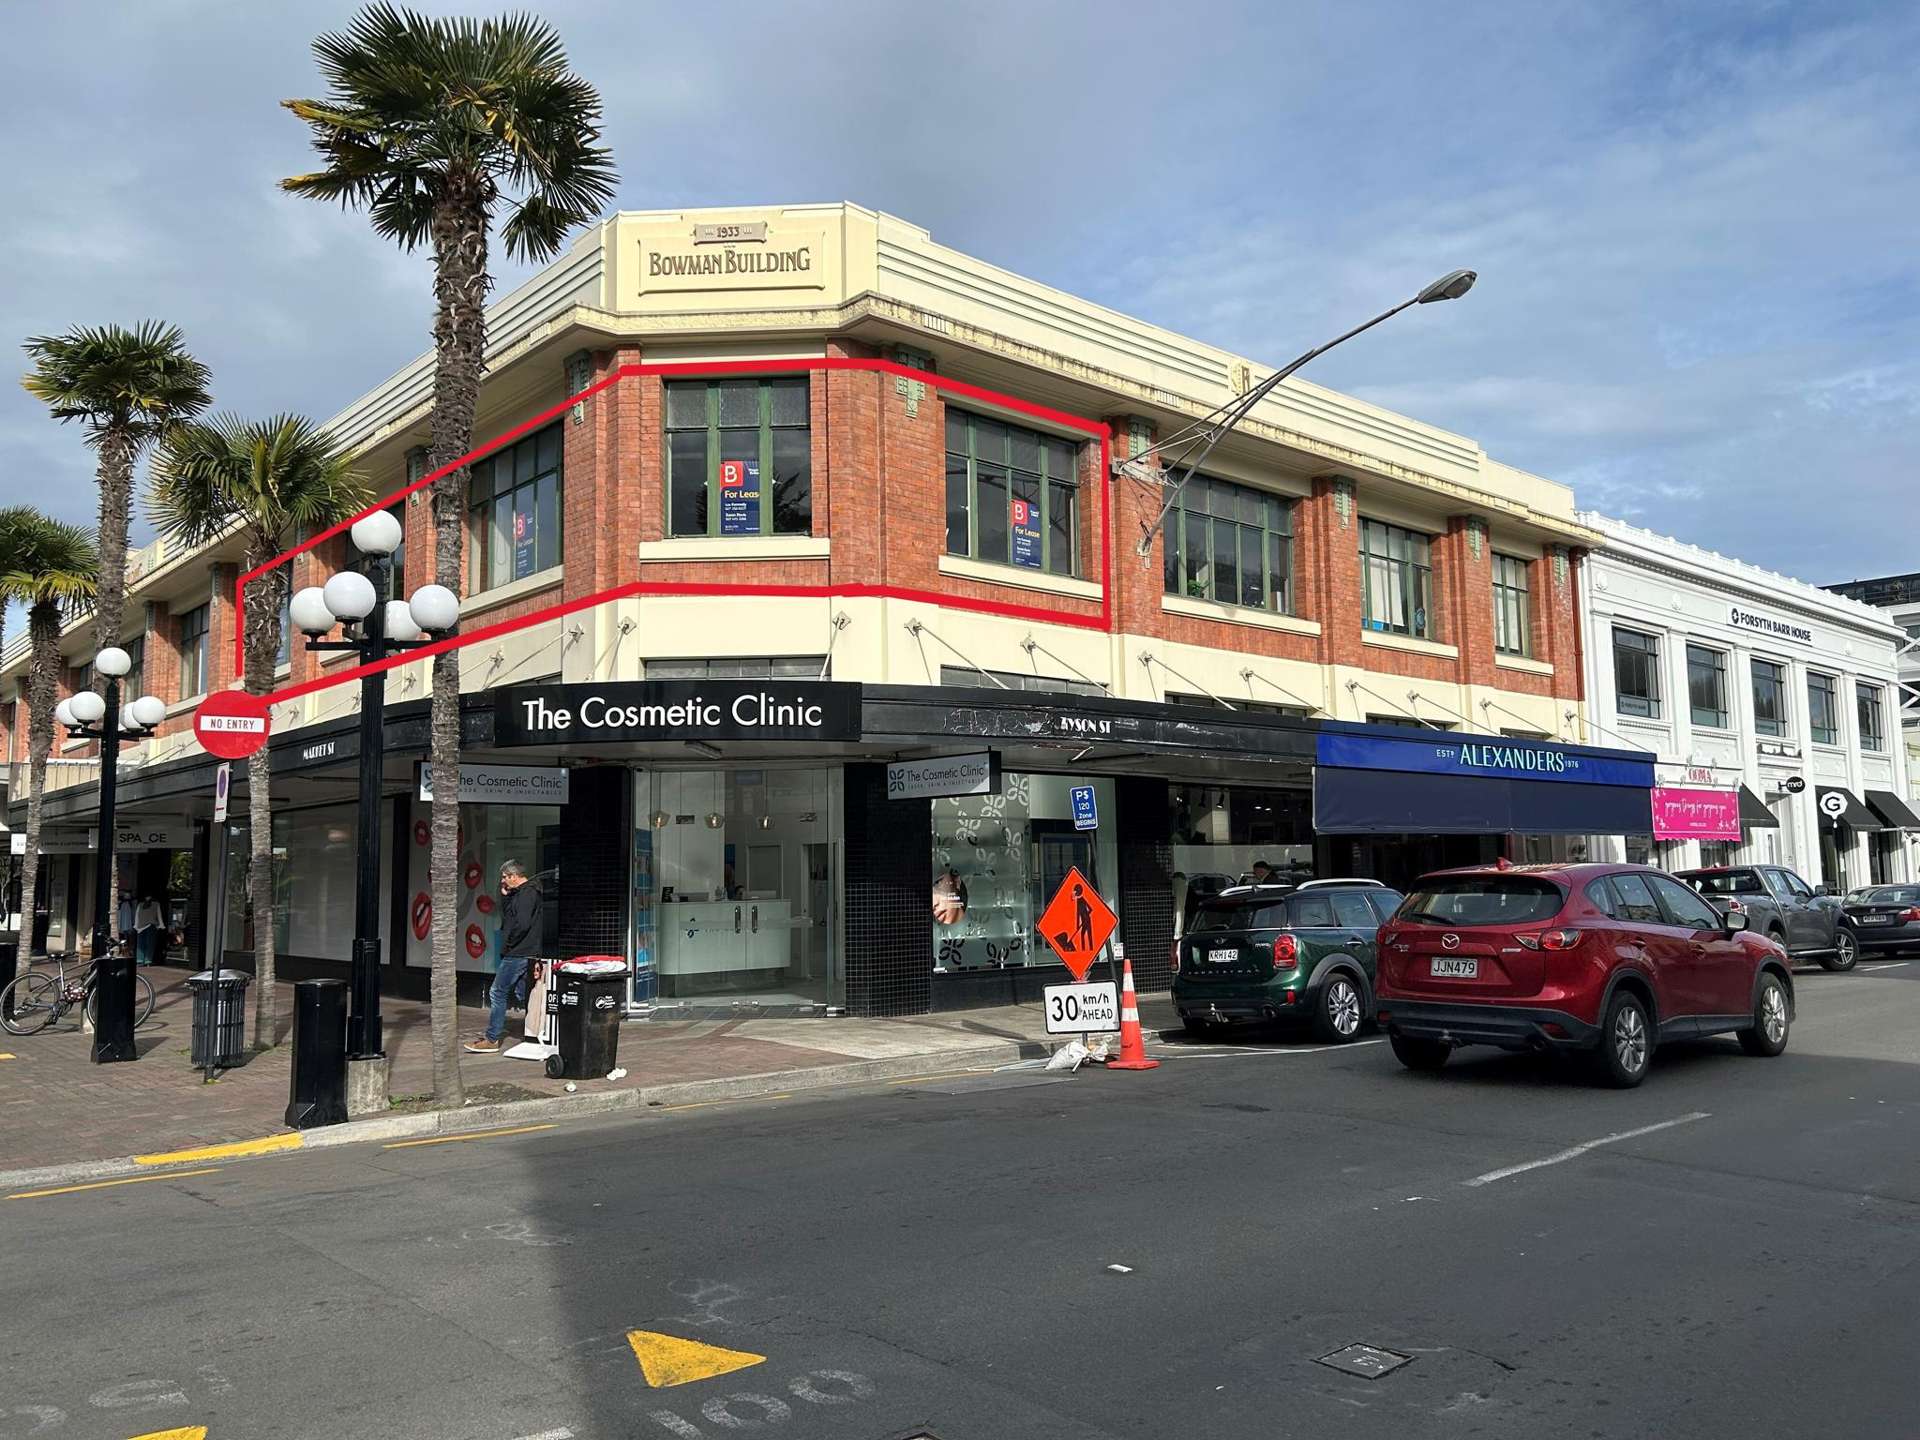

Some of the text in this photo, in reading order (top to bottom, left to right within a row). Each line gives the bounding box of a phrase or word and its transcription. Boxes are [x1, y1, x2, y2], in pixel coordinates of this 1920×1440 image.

[717, 226, 740, 238] 1933
[649, 247, 811, 277] BOWMAN BUILDING
[724, 465, 738, 483] B
[724, 490, 760, 499] For Leas
[1015, 504, 1024, 520] B
[1015, 526, 1040, 538] For Lease
[1740, 613, 1812, 642] FORSYTH BARR HOUSE
[522, 692, 822, 731] The Cosmetic Clinic
[210, 718, 255, 730] NO ENTRY
[1099, 719, 1111, 734] ST
[303, 741, 335, 760] MARKET ST
[1460, 743, 1565, 773] ALEXANDERS
[459, 772, 562, 789] he Cosmetic Clinic
[907, 764, 984, 782] The Cosmetic Clinic
[1078, 801, 1090, 811] 120
[1824, 796, 1841, 812] G
[119, 833, 168, 845] SPA_CE
[1208, 950, 1238, 960] KRH142
[1433, 962, 1475, 974] JJN479
[1052, 993, 1110, 1022] 30 km/h
[1082, 1008, 1113, 1021] AHEAD
